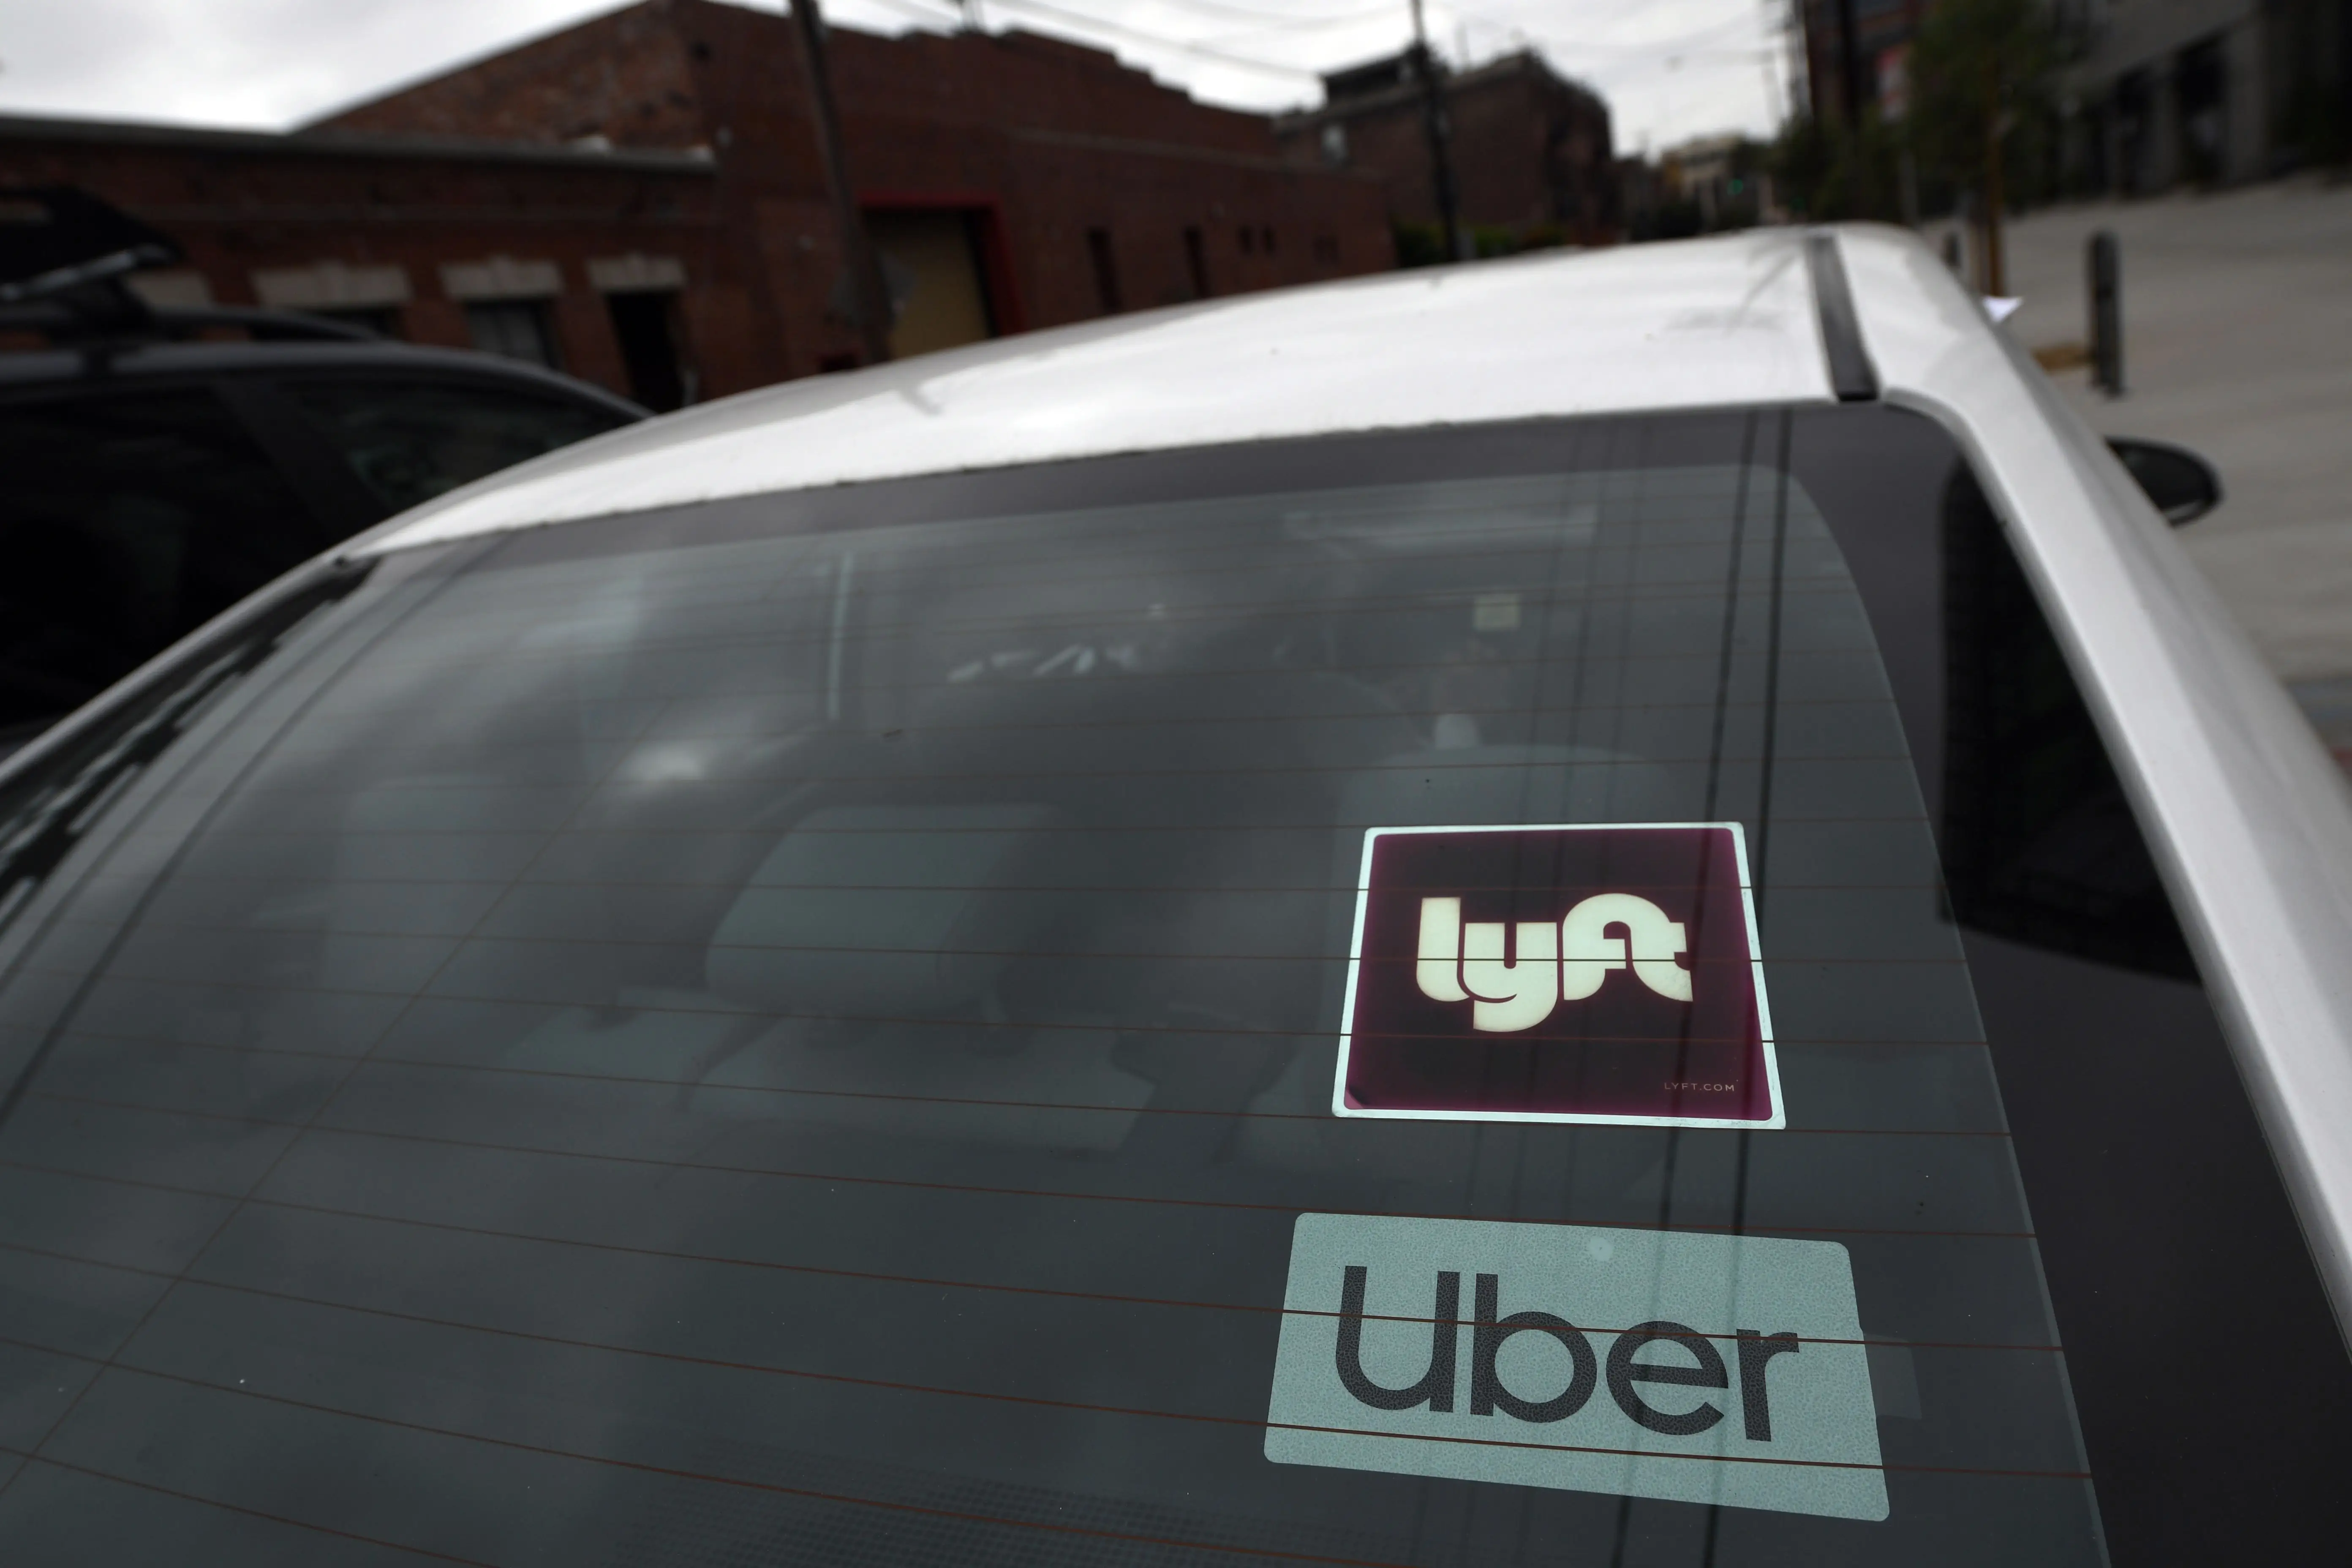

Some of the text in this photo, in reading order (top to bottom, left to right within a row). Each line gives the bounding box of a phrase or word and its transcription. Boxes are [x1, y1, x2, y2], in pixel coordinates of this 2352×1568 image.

[1416, 893, 1693, 1032] lyft
[1664, 1082, 1734, 1092] LYFT.COM
[1335, 1265, 1800, 1442] Uber
